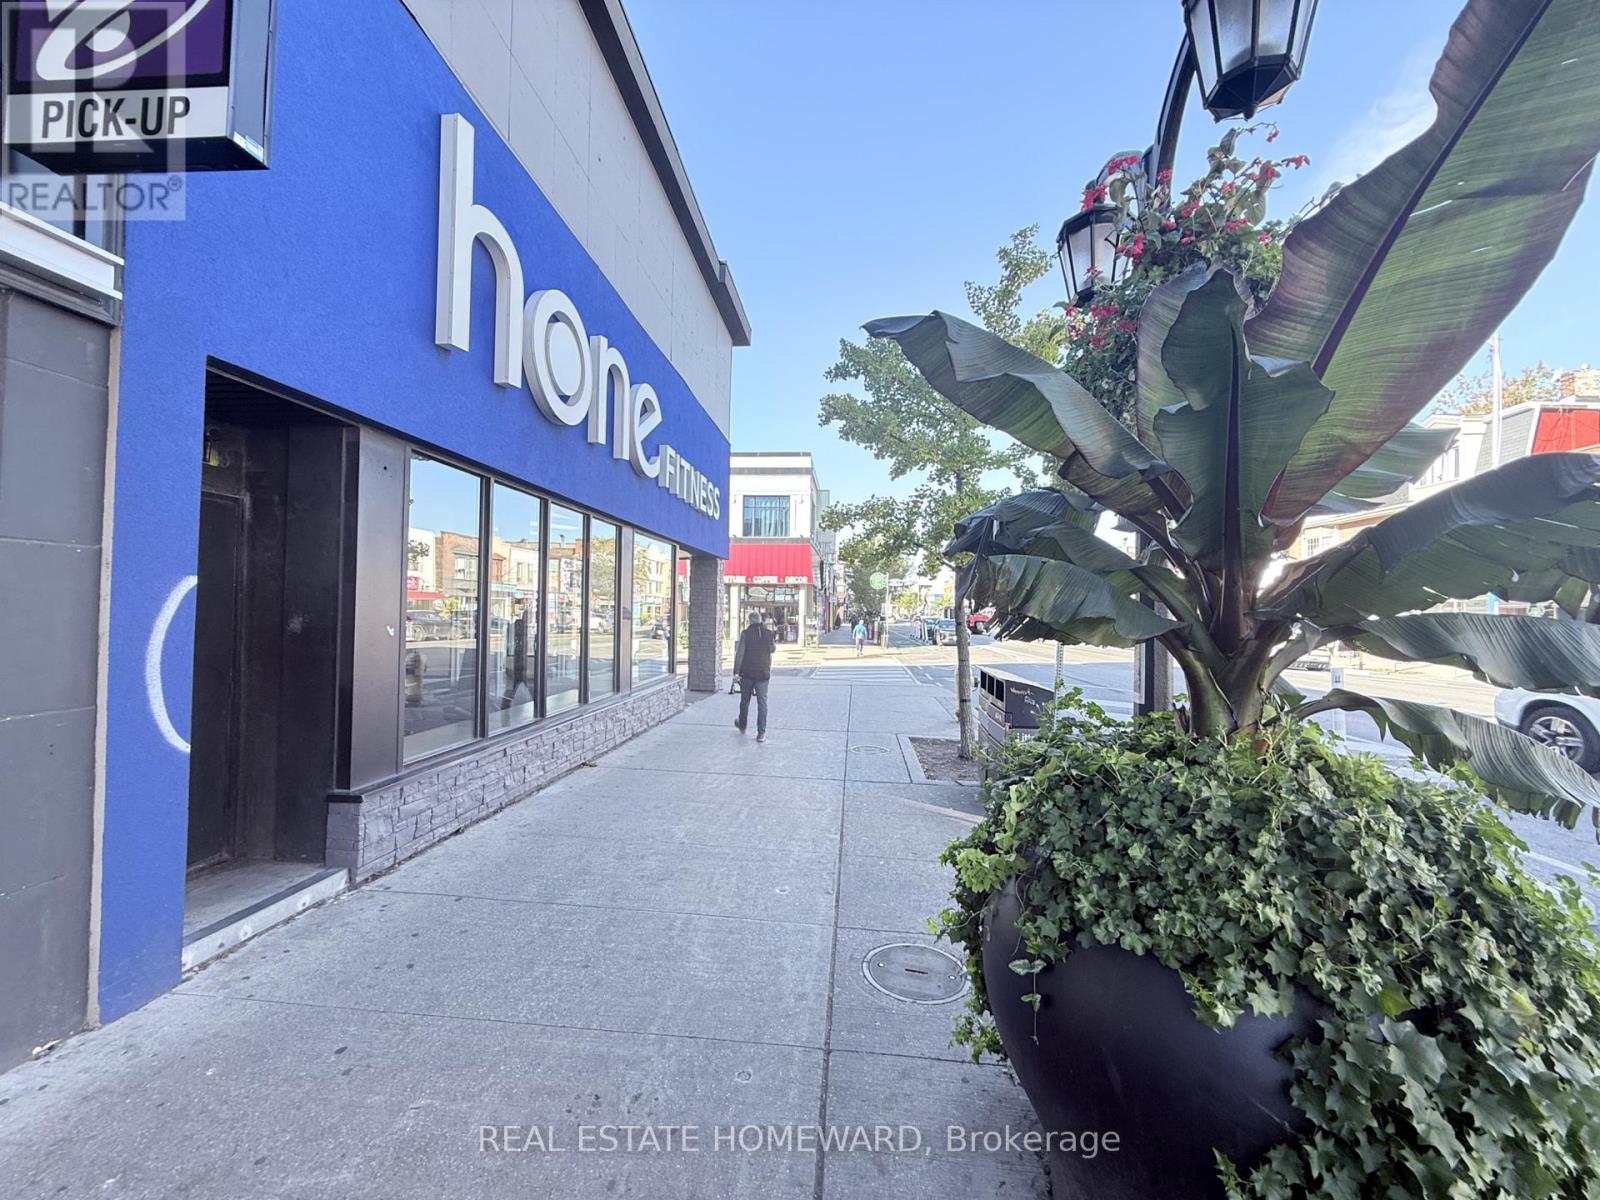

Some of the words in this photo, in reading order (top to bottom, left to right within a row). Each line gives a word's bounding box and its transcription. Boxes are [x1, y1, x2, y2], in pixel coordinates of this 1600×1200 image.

[42, 96, 190, 139] PICK-UP
[435, 112, 662, 479] hone
[658, 444, 720, 521] FITNESS
[753, 575, 777, 583] COFFEE
[785, 575, 808, 583] DECOR
